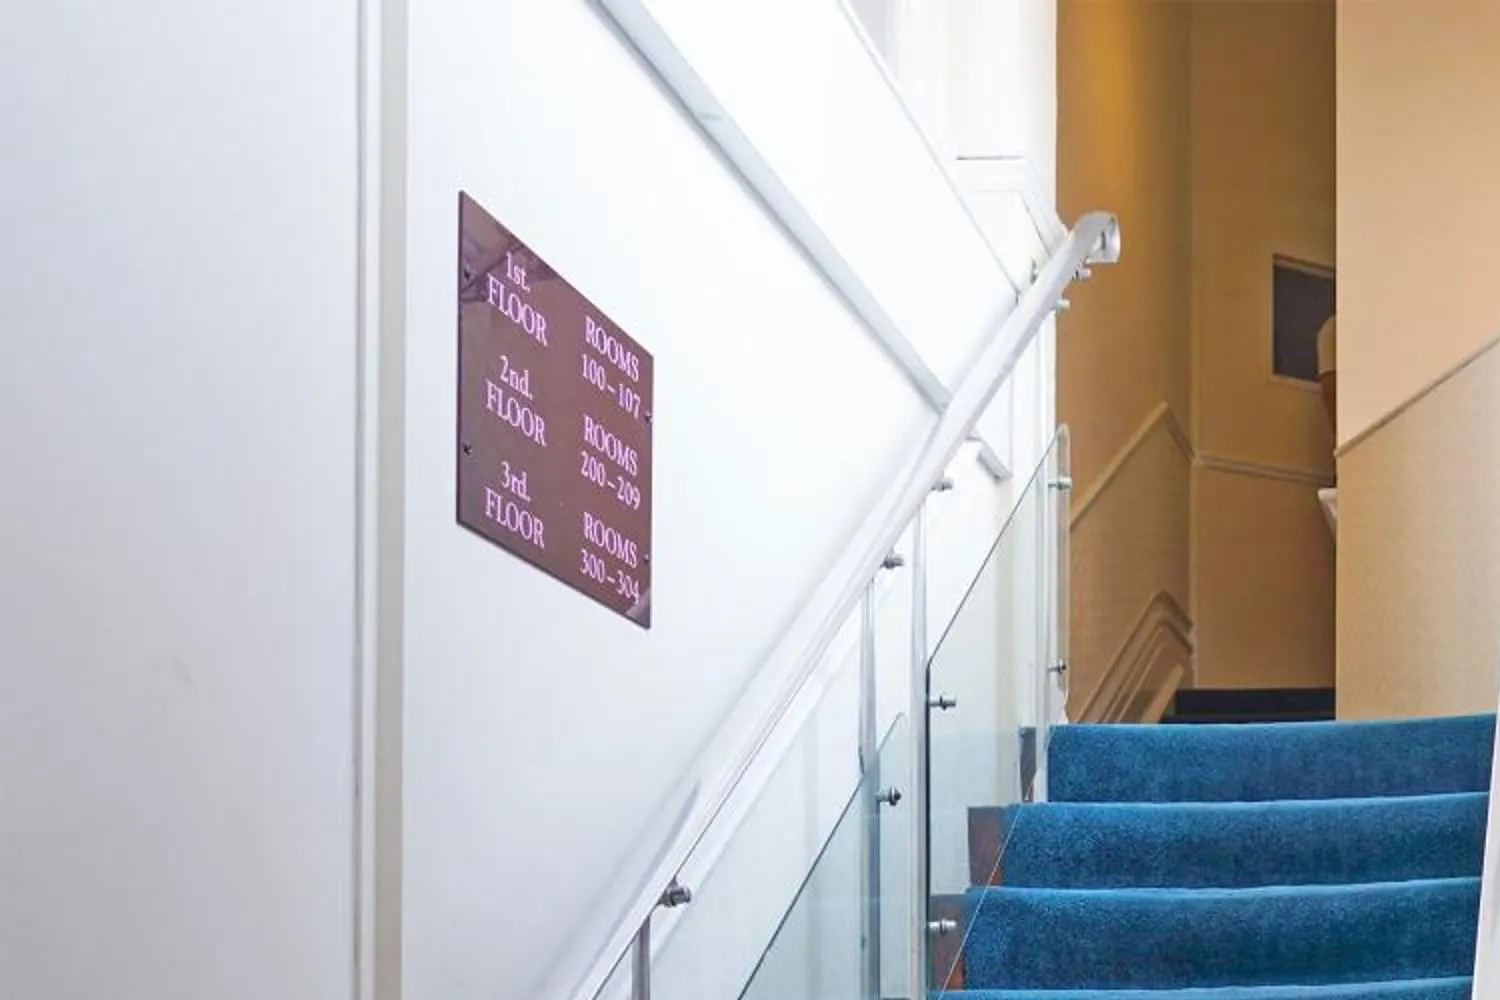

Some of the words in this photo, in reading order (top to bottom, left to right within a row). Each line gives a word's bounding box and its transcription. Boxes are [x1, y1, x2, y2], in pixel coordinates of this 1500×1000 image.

[506, 251, 530, 293] 1st.
[487, 272, 549, 347] FLOOR
[500, 355, 533, 400] 2nd.
[585, 315, 640, 383] ROOMS
[485, 378, 548, 447] FLOOR
[583, 413, 638, 477] ROOMS
[501, 460, 531, 502] 3rd.
[484, 486, 545, 549] FLOOR
[583, 511, 637, 569] ROOMS
